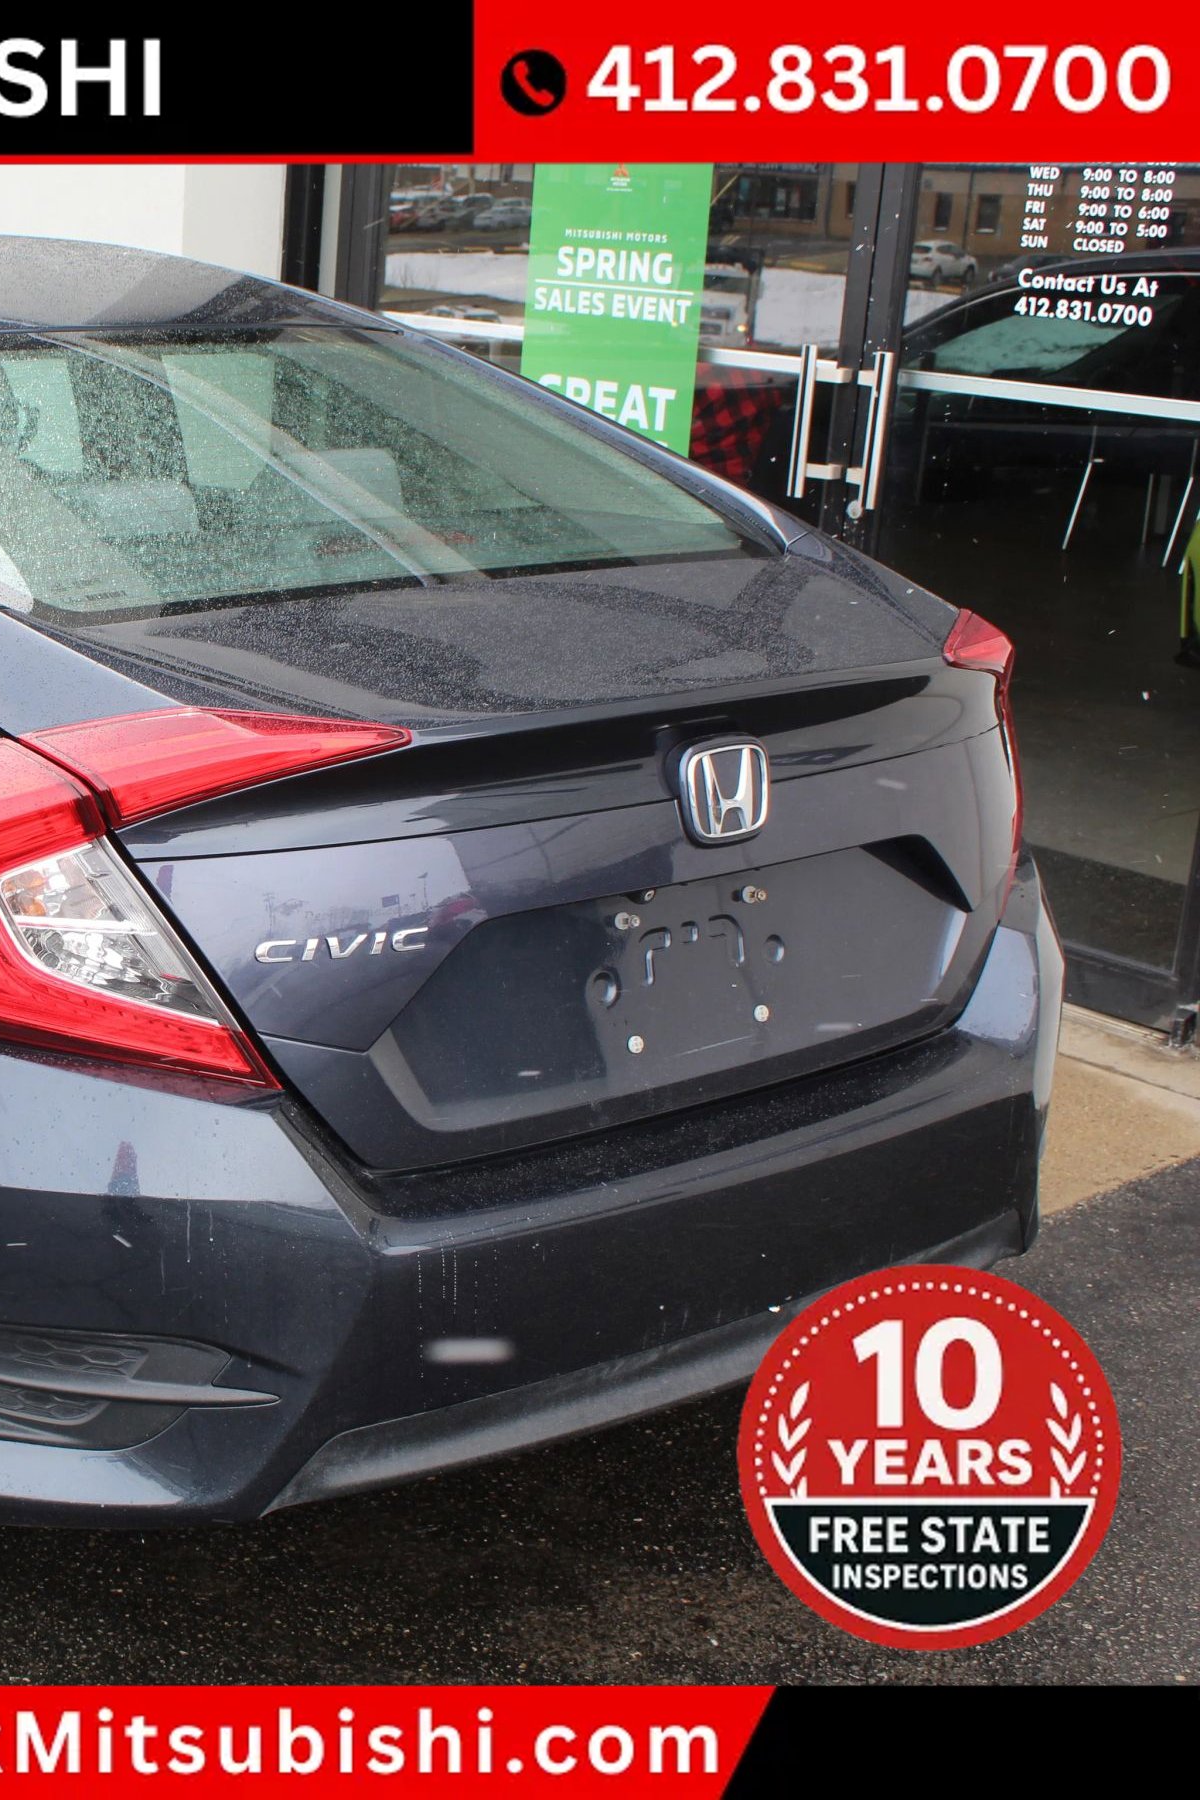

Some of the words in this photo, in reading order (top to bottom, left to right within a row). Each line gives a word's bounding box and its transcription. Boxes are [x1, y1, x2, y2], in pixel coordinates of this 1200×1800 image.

[1030, 166, 1060, 180] WED
[1083, 168, 1112, 182] 9:00
[1119, 169, 1138, 183] TO
[1143, 170, 1175, 185] 8:00
[1027, 183, 1053, 197] THU
[1080, 186, 1110, 200] 9:00
[1116, 187, 1135, 201] TO
[1141, 189, 1173, 203] 8:00
[1025, 201, 1045, 214] FRI
[1078, 203, 1107, 217] 9:00
[1114, 205, 1132, 219] TO
[1138, 206, 1169, 220] 6:00
[565, 228, 622, 241] MITSUBISHI
[626, 233, 668, 244] MOTORS
[1023, 217, 1047, 231] SAT
[1075, 220, 1104, 234] 9:00
[1110, 223, 1128, 236] TO
[1136, 224, 1167, 238] 5:00
[1020, 234, 1048, 249] SUN
[1073, 238, 1125, 253] CLOSED
[557, 246, 672, 285] SPRING
[1018, 268, 1095, 293] Contact
[1100, 274, 1127, 295] Us
[1132, 277, 1159, 298] At
[534, 287, 606, 316] SALES
[611, 293, 692, 324] EVENT
[1014, 296, 1153, 327] 412.831.0700
[255, 926, 429, 963] CIVIC
